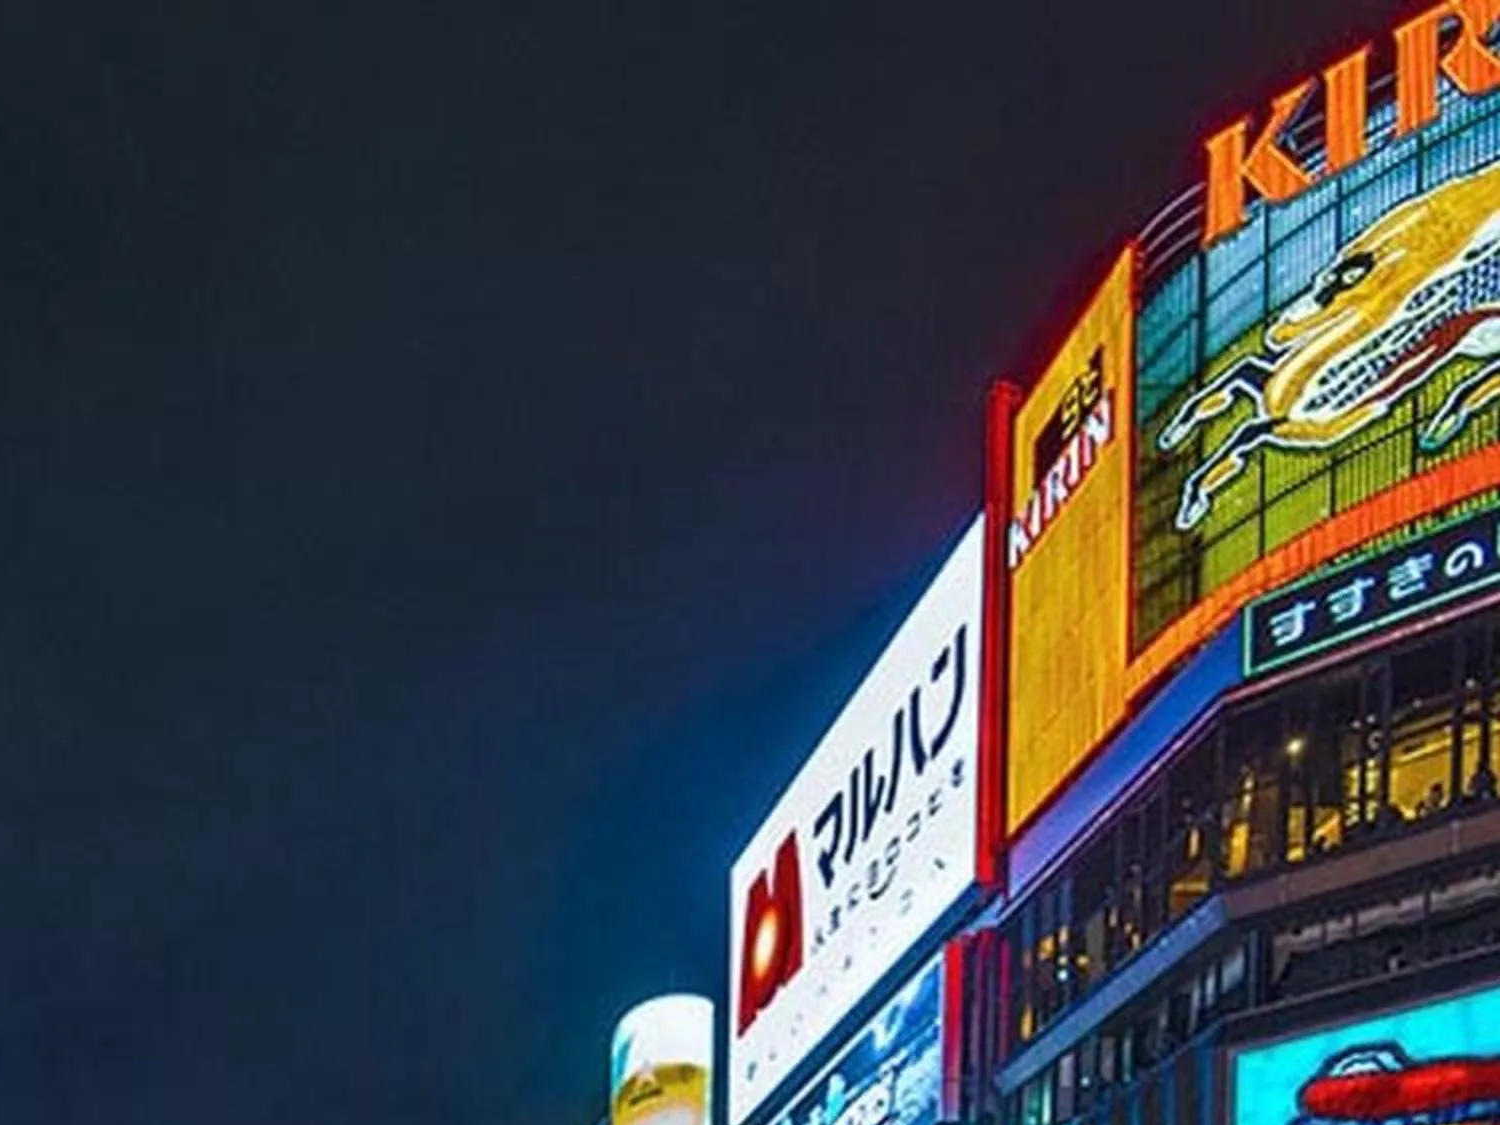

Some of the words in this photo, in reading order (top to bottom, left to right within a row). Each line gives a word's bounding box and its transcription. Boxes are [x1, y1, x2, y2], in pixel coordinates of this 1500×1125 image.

[1008, 394, 1113, 569] KIRIN
[813, 624, 967, 889] マルハン
